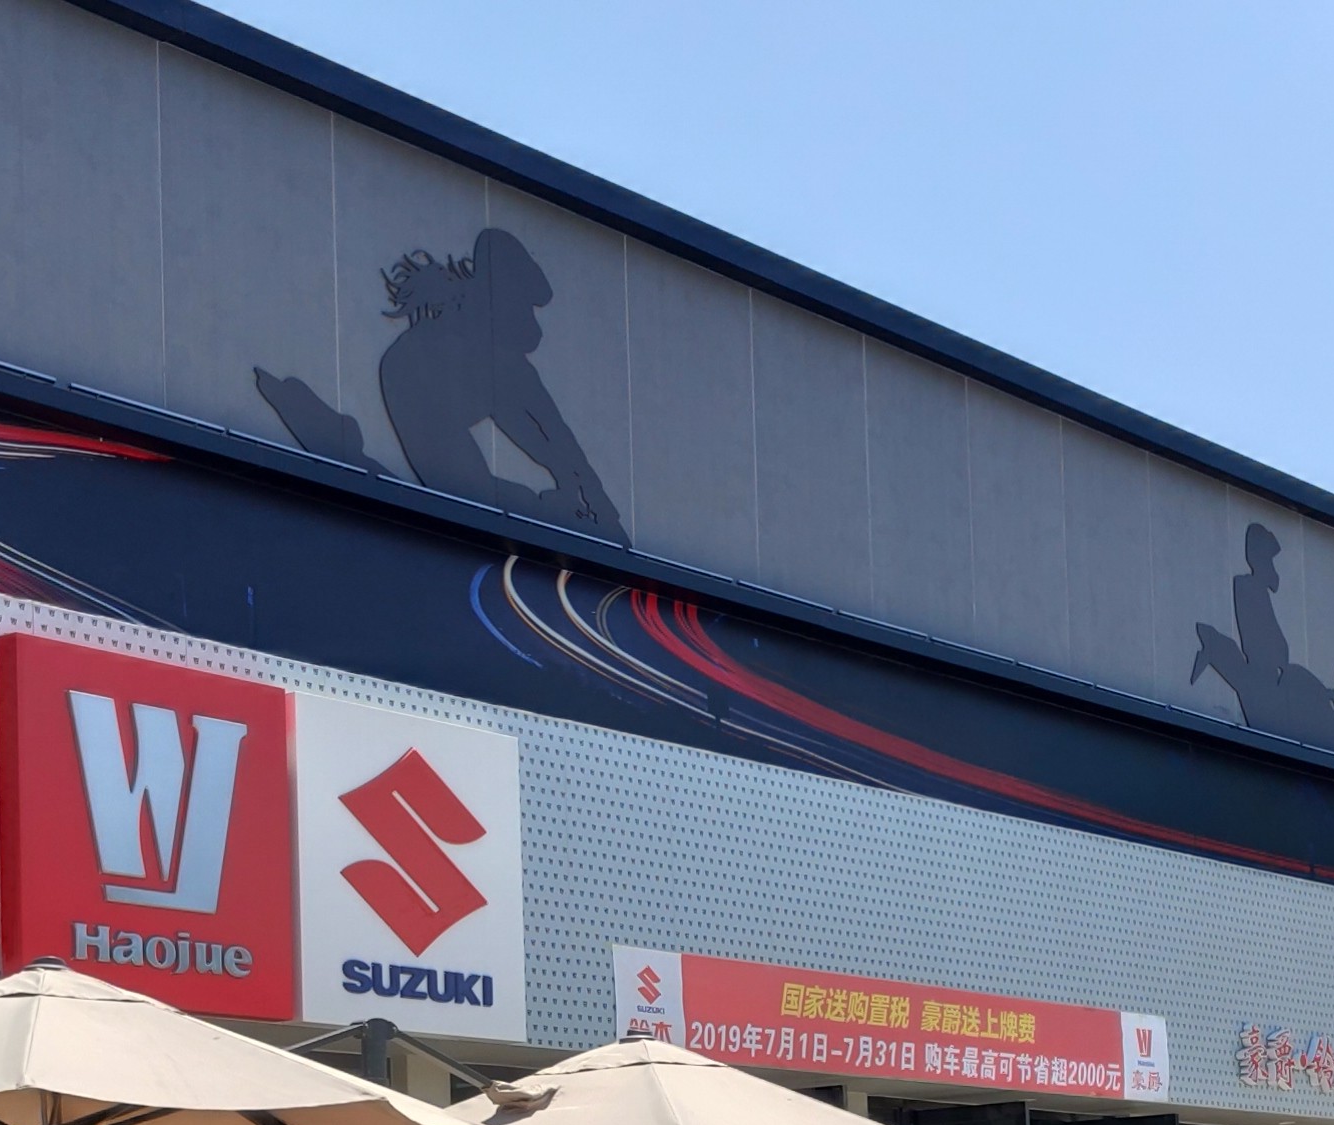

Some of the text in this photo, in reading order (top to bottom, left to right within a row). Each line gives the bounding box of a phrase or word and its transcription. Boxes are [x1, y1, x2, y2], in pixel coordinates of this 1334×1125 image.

[71, 921, 253, 978] Haojue
[342, 958, 494, 1007] SUZUKI
[637, 1005, 665, 1015] SUZUKI
[780, 982, 1036, 1044] 国家送购置税 豪爵送上牌费
[925, 1042, 1121, 1091] 购车最高可节省超2000元
